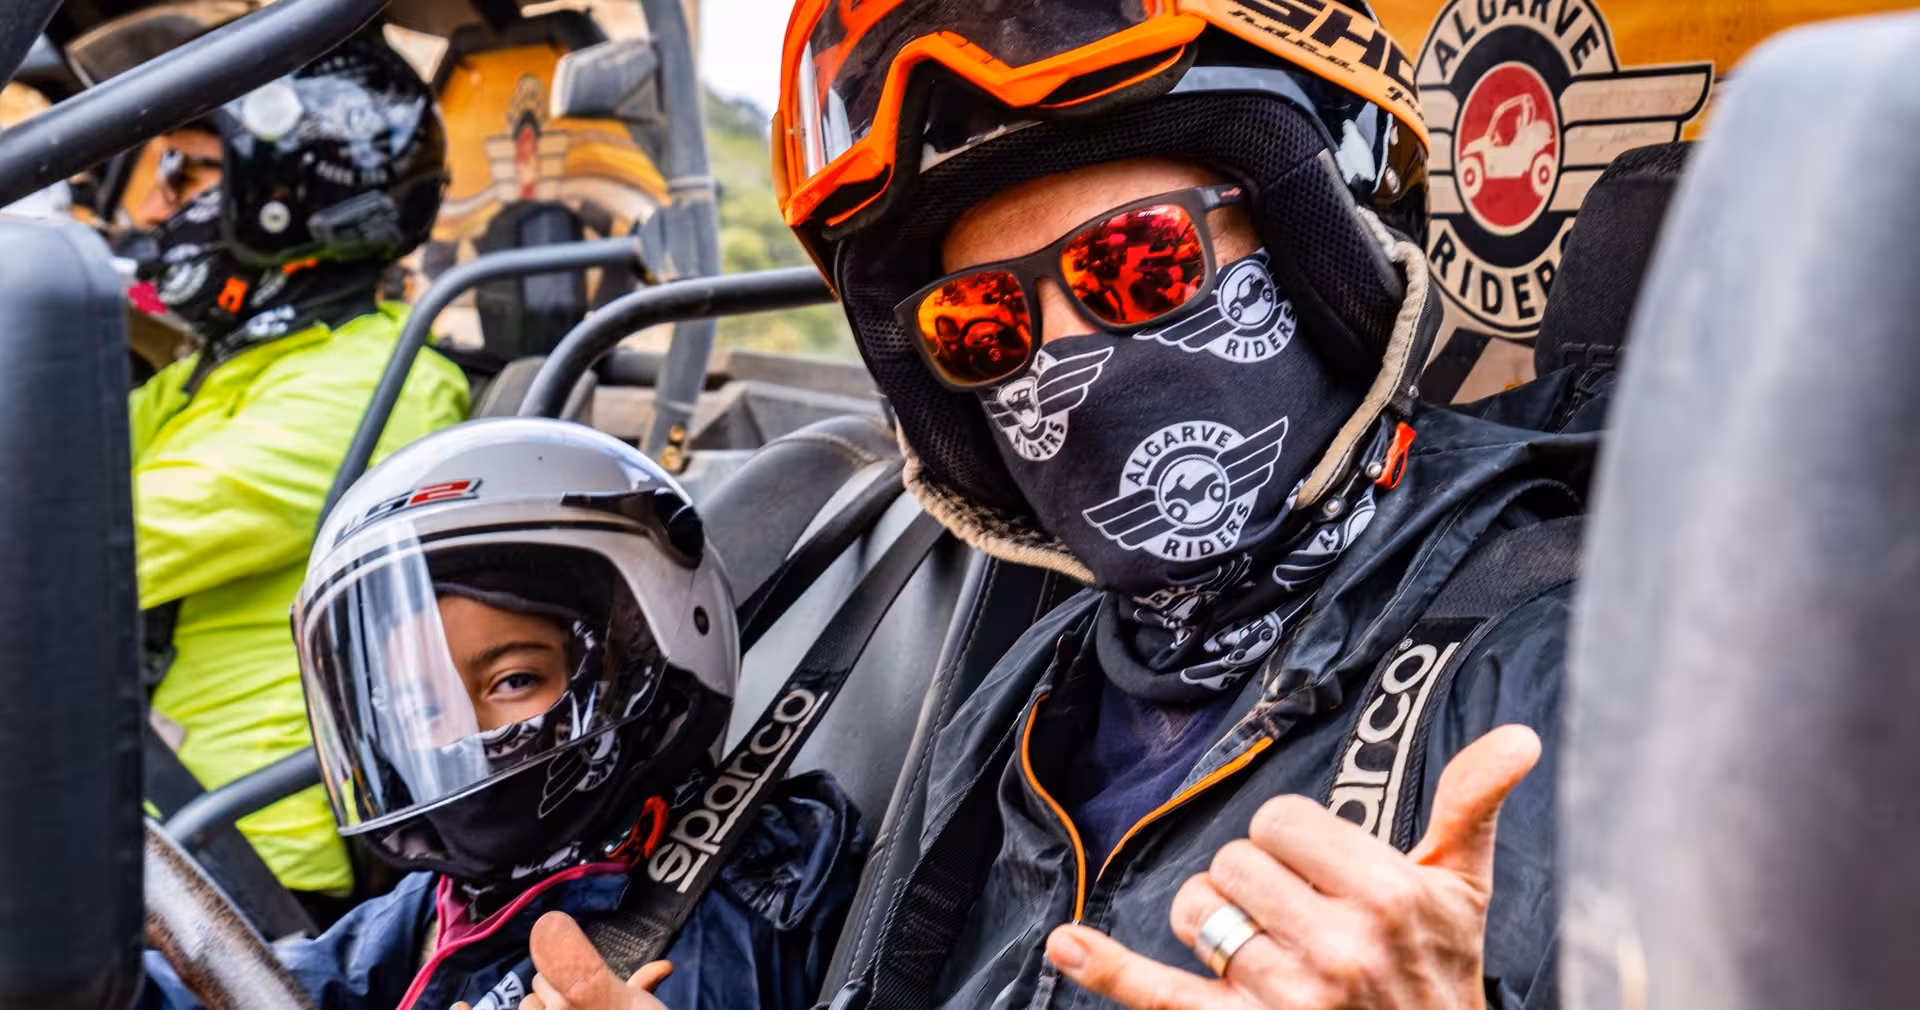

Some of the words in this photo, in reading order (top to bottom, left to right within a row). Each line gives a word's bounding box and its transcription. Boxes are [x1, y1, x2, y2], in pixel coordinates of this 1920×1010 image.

[1429, 228, 1574, 320] RIDER
[1125, 425, 1232, 487] ALGARVE
[1162, 502, 1249, 558] RIDERS
[647, 688, 817, 884] sparco
